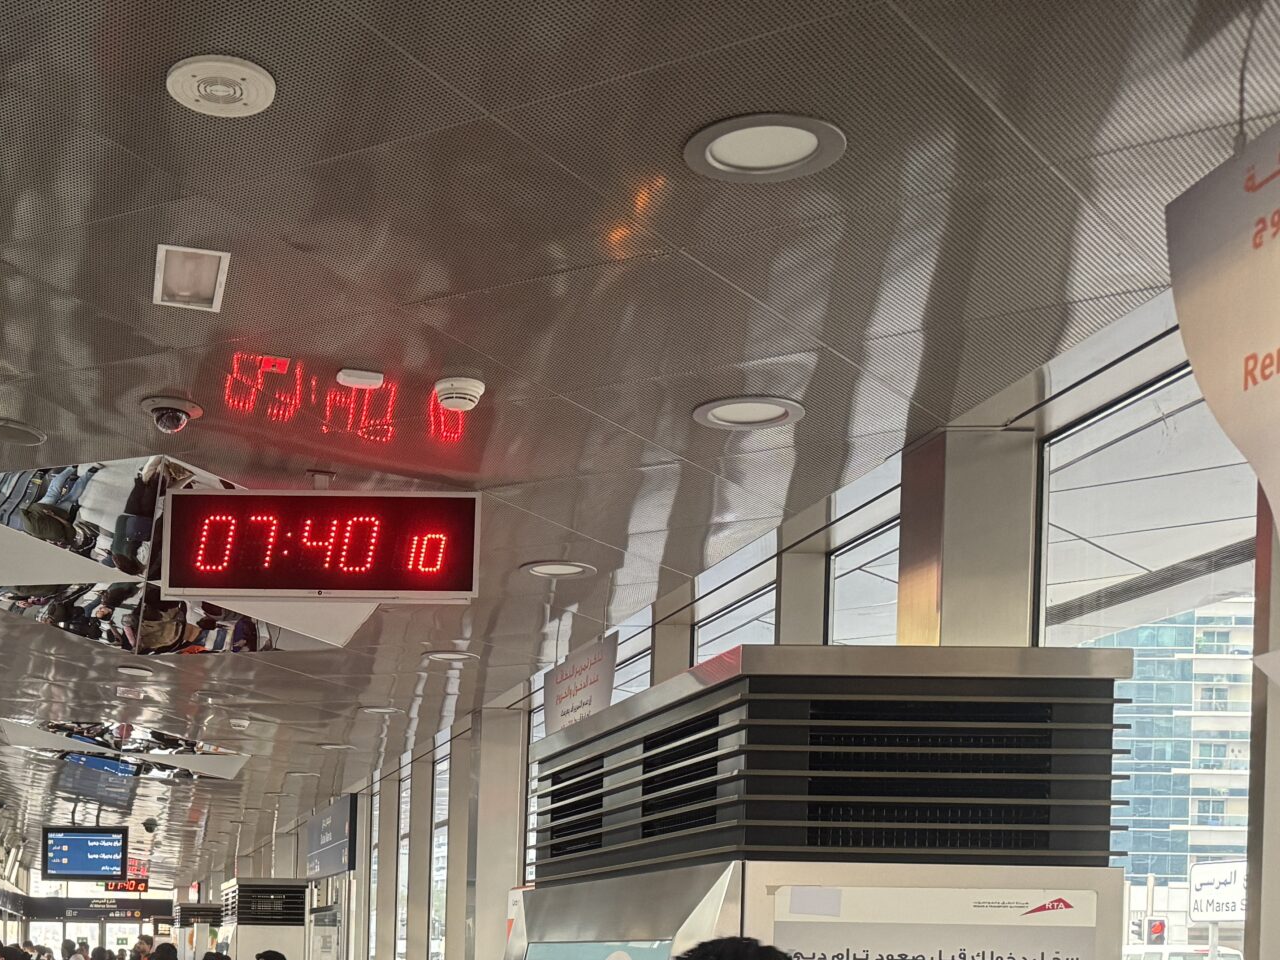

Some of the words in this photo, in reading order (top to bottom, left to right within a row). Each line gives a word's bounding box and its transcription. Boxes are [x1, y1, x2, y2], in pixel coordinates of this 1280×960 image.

[196, 515, 380, 573] 07:40
[408, 533, 447, 573] 10
[1194, 870, 1237, 892] المرسى
[1193, 899, 1203, 912] Al
[1206, 899, 1236, 912] Marsa
